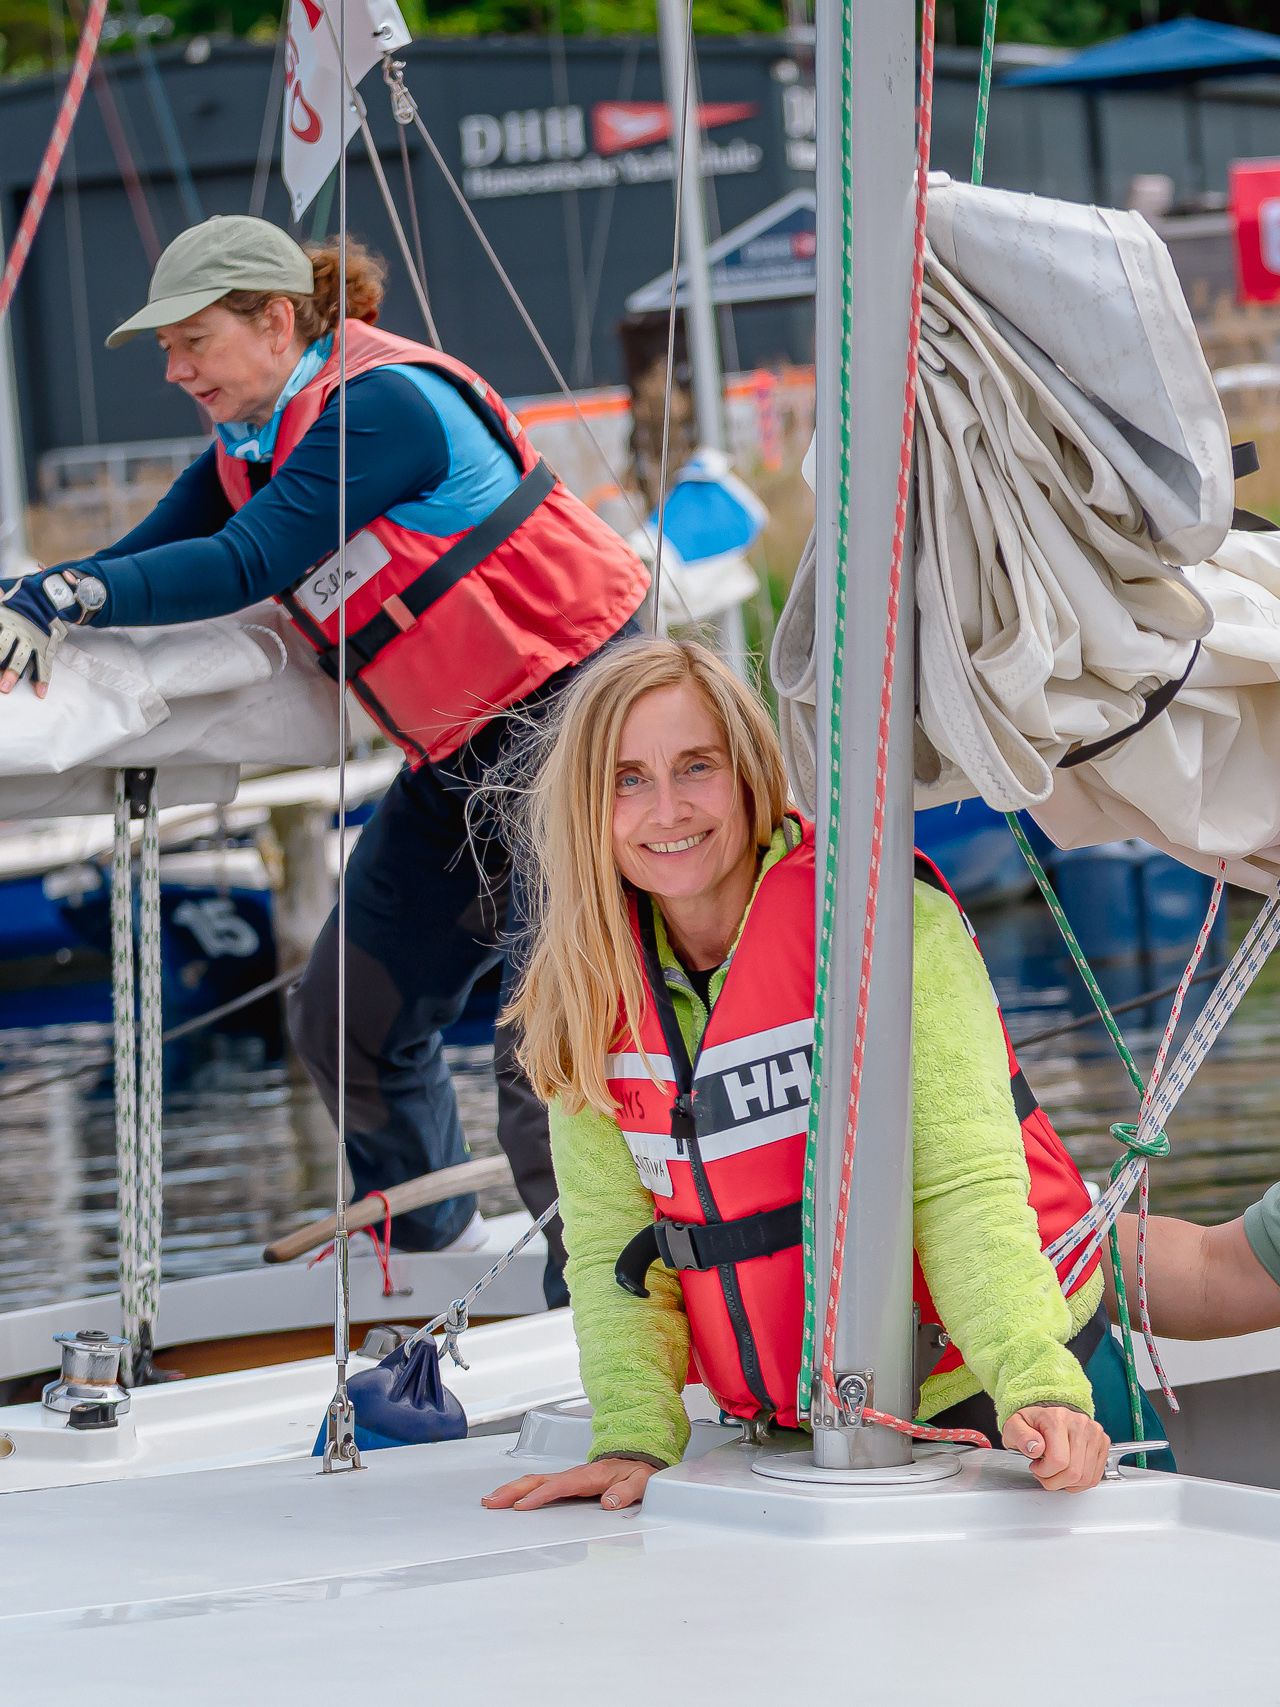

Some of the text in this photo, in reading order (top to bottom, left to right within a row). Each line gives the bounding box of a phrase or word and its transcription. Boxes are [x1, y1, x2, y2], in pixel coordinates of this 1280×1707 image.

[459, 105, 586, 167] DHH
[173, 899, 260, 958] 15
[722, 1051, 813, 1121] HH
